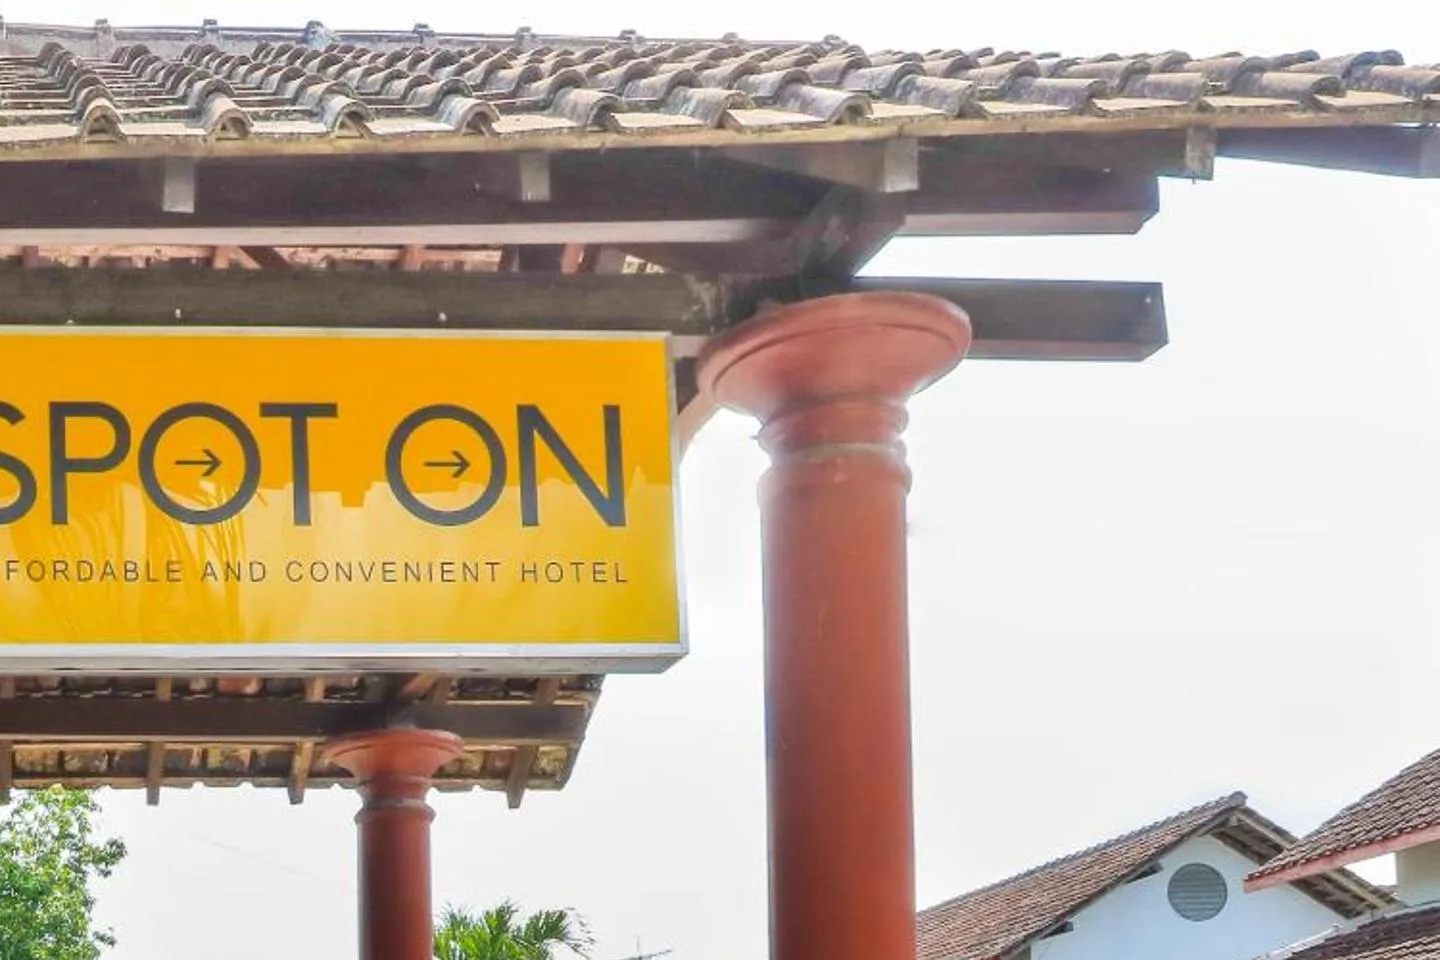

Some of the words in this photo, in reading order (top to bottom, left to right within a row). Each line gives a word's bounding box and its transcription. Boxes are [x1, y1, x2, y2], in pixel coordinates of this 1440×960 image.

[384, 403, 628, 528] ON
[200, 560, 268, 583] AND
[285, 560, 501, 584] CONVENIENT
[521, 561, 629, 584] HOTEL
